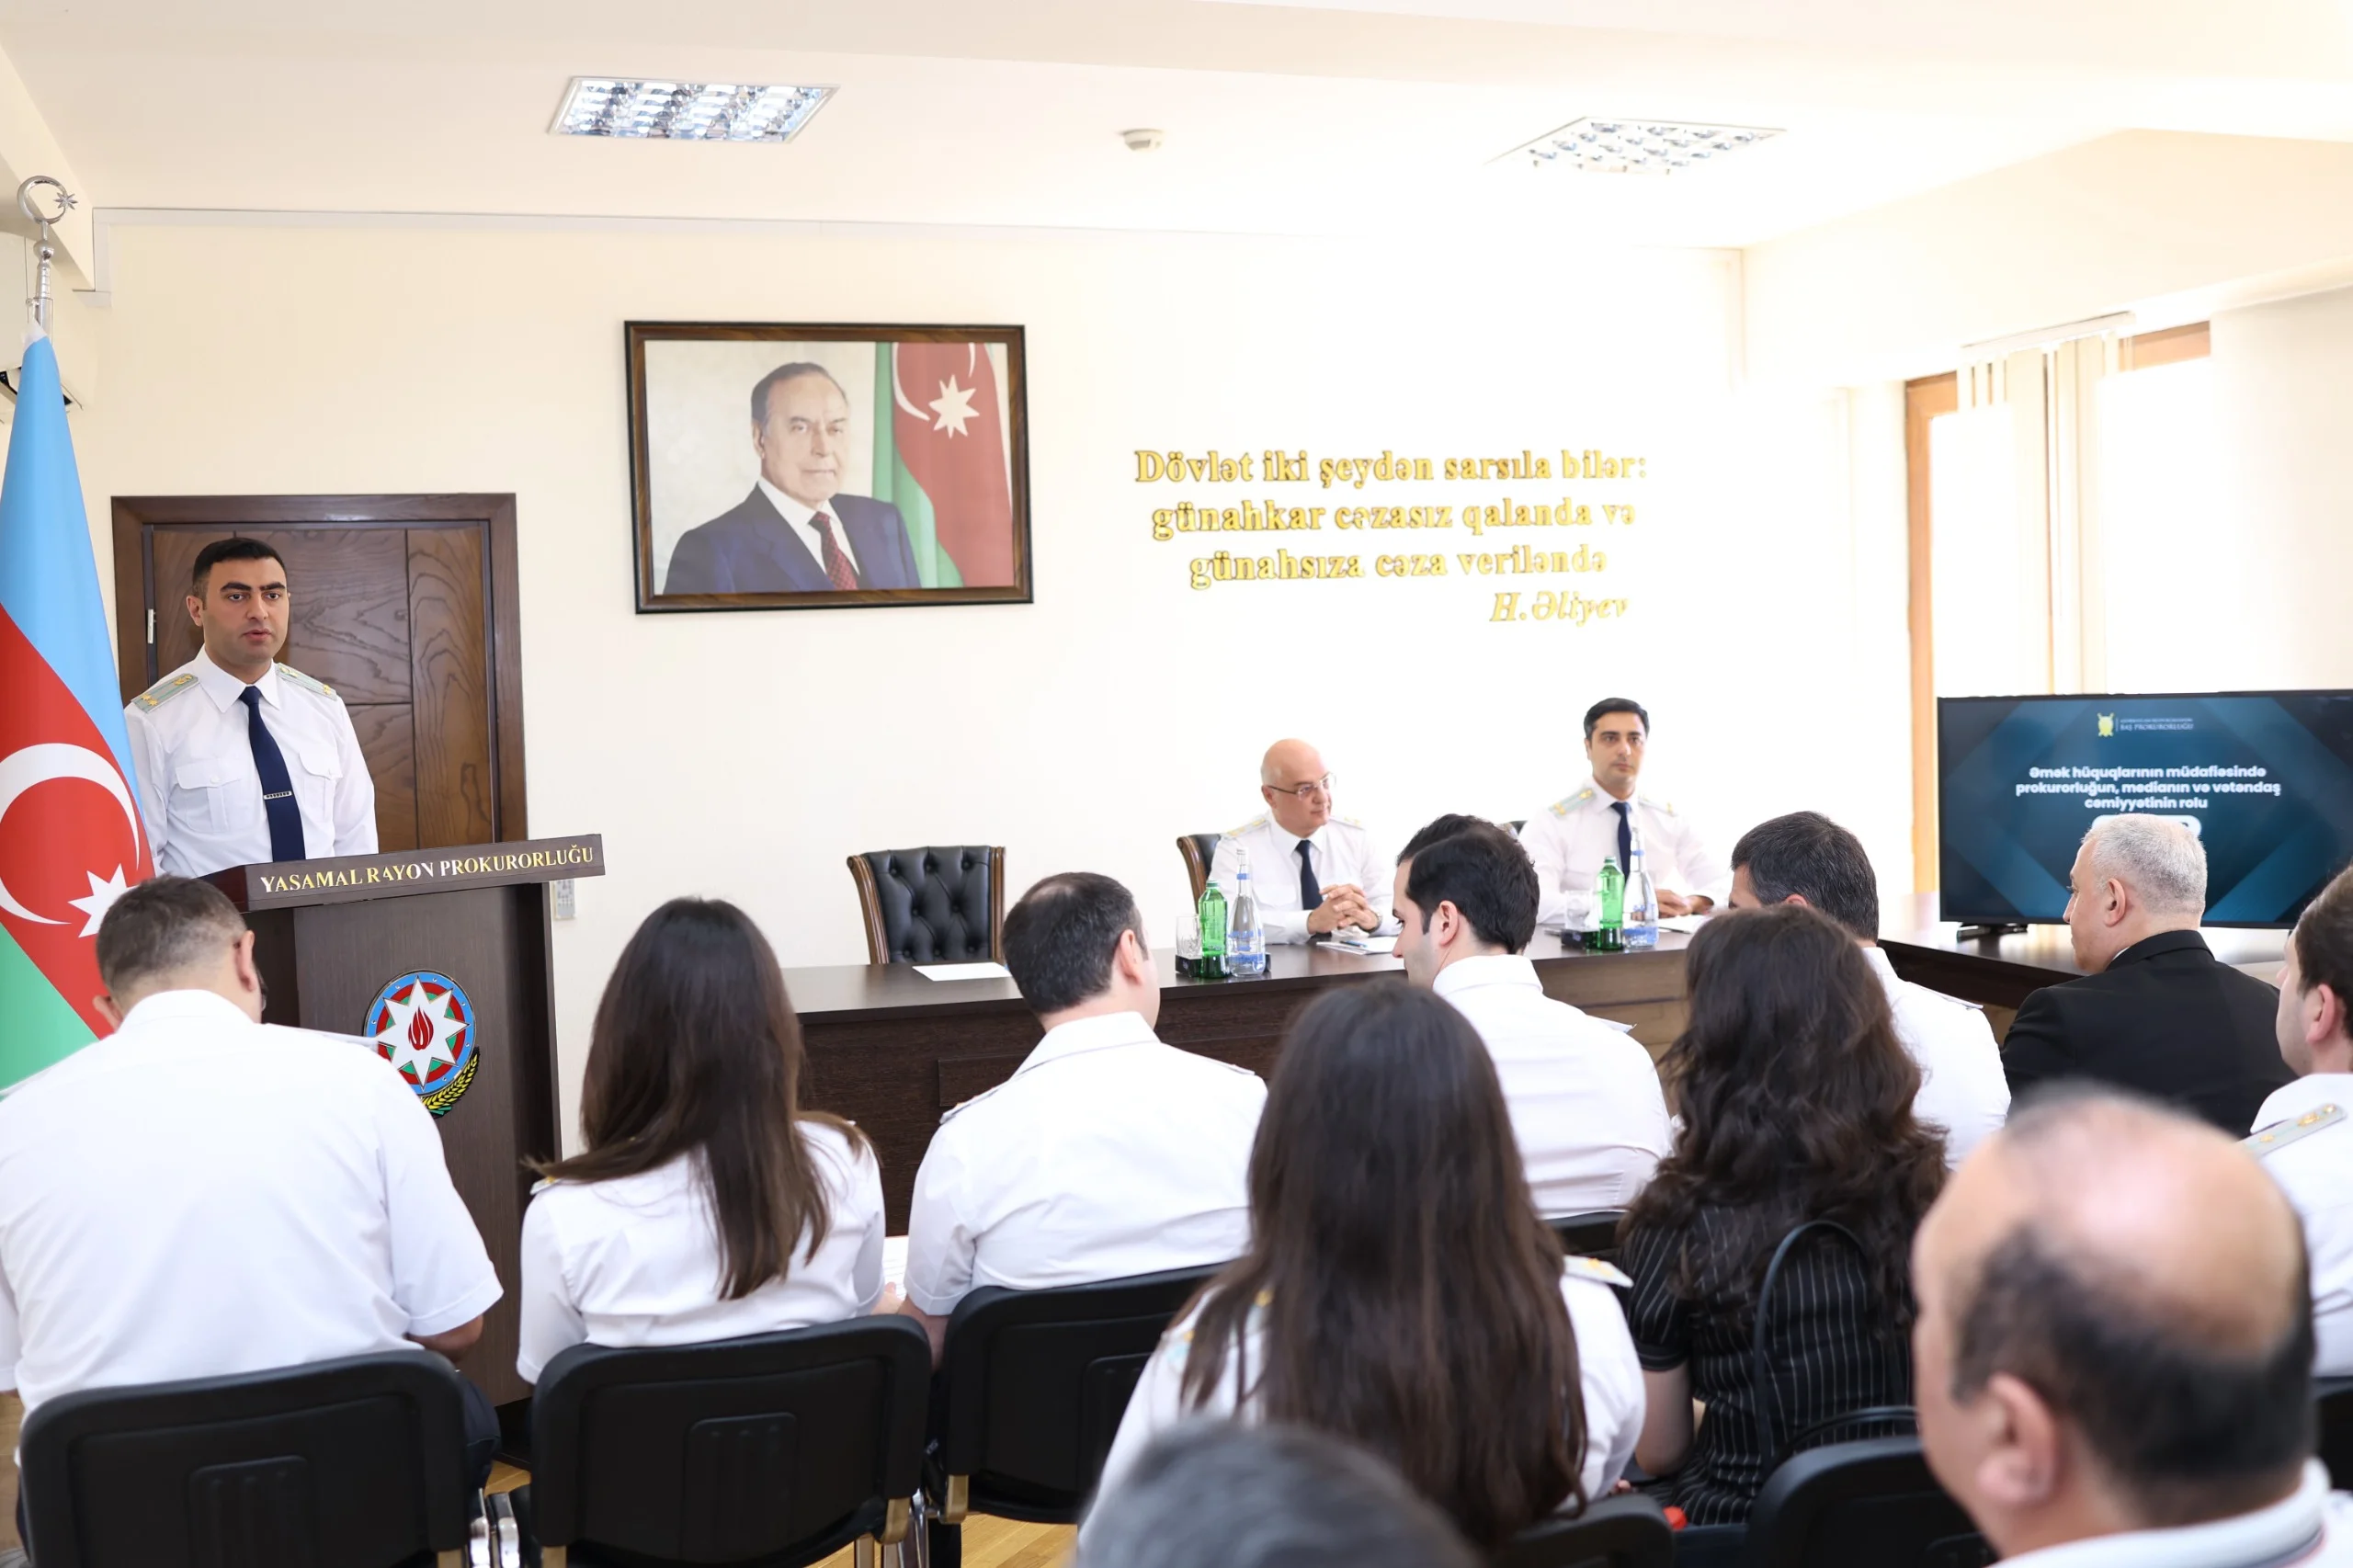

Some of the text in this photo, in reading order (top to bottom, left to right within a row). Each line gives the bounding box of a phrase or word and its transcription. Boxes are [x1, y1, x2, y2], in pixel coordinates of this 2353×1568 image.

[1134, 449, 1648, 488] Dövlət iki şeydən sarsıla bilər:
[1152, 497, 1636, 540] günahkar cəzasız qalanda və
[1189, 544, 1608, 589] günahsıza cəza veriləndə
[2015, 780, 2281, 797] prokurorluğun, medianın və vətəndaş
[2029, 765, 2267, 781] Əmək hüquqlarının müdafiəsində
[2084, 796, 2208, 812] cəmiyyətinin rolu
[260, 844, 594, 894] YASAMAL RAYON PROKURORLUĞU
